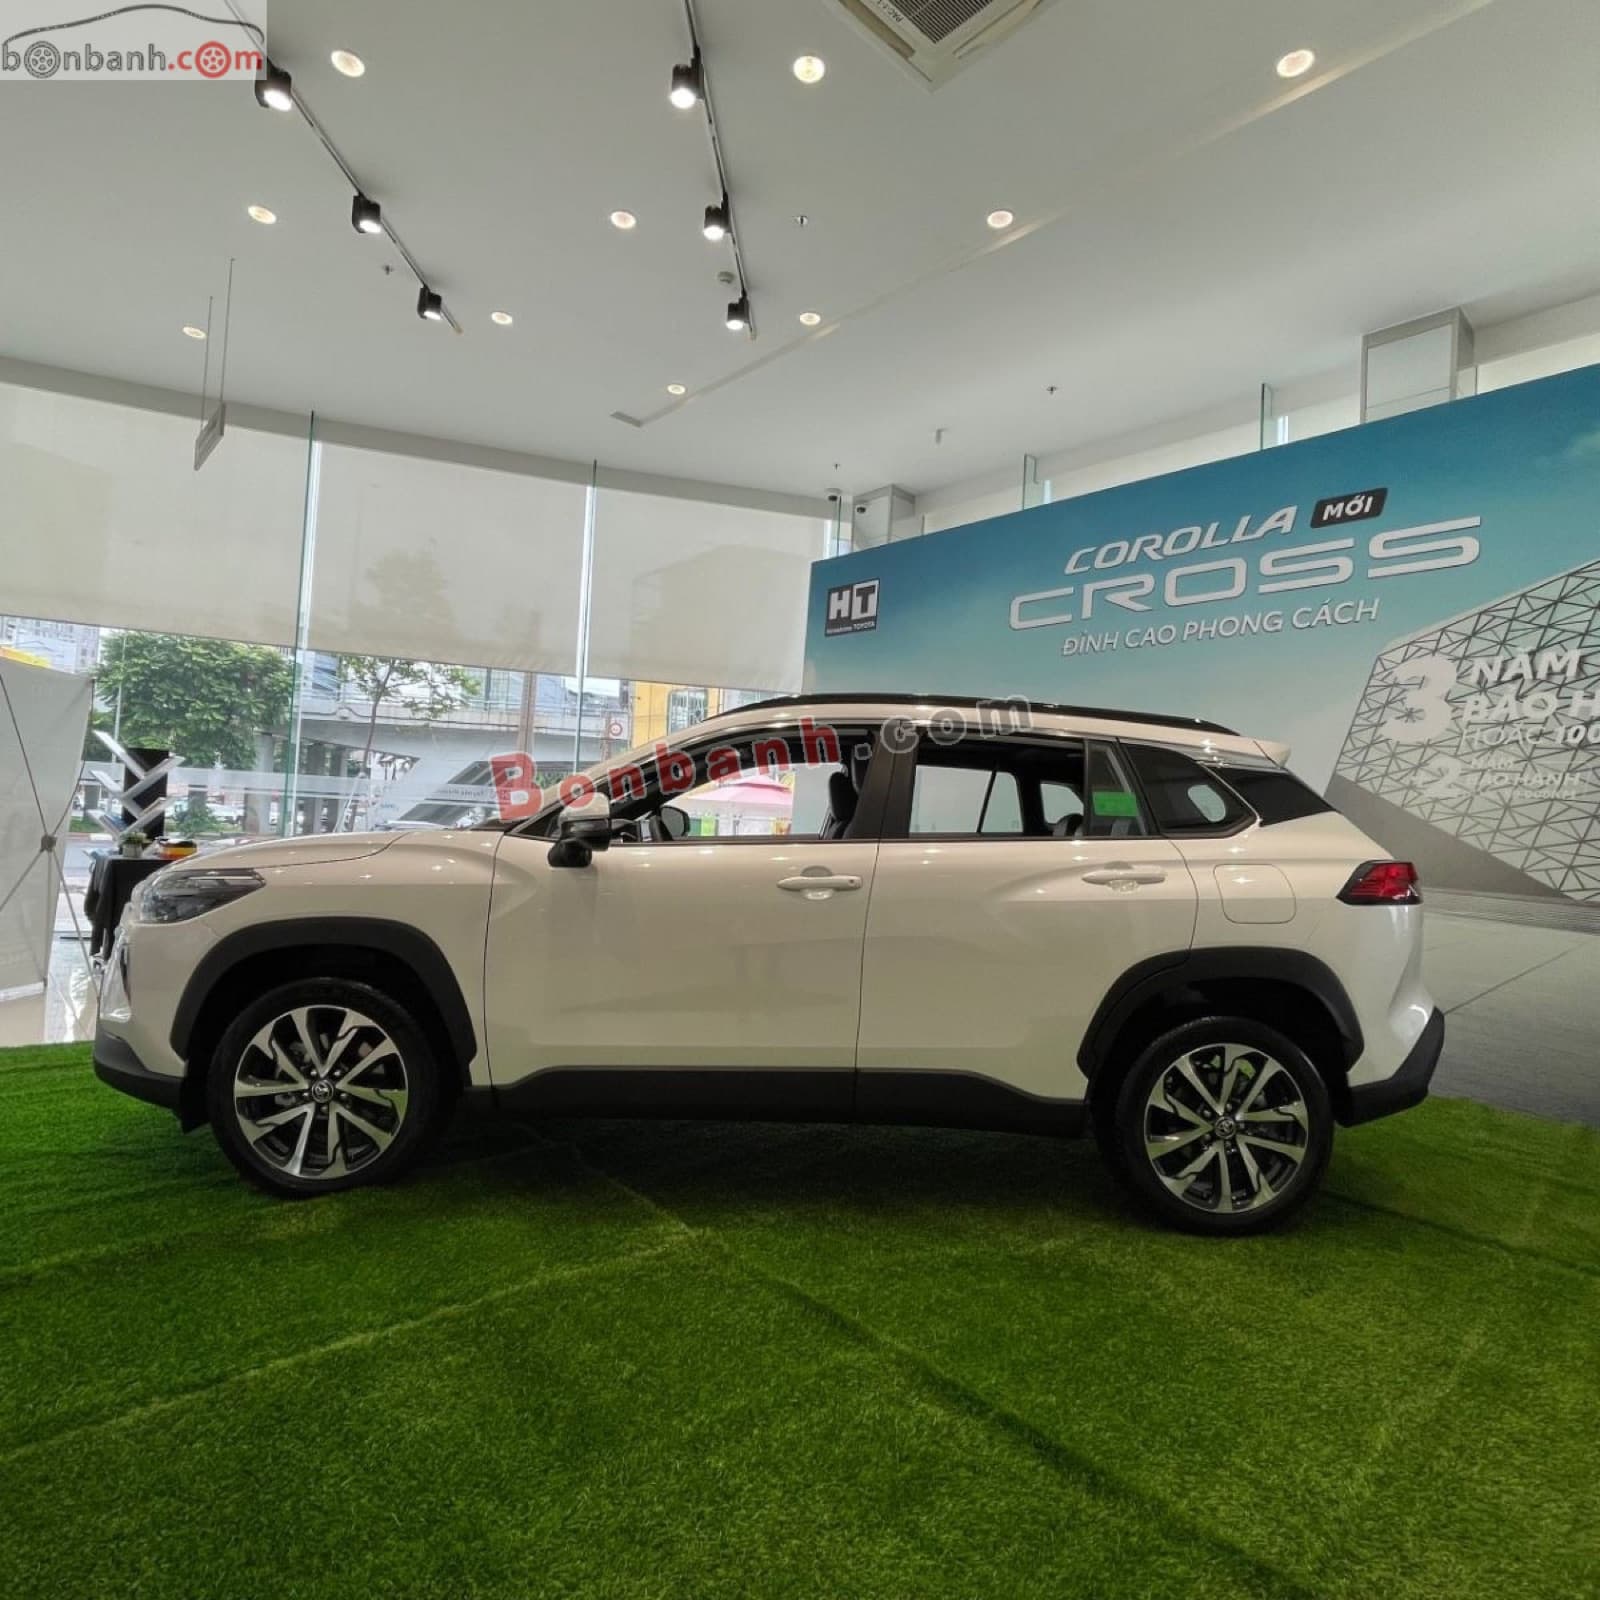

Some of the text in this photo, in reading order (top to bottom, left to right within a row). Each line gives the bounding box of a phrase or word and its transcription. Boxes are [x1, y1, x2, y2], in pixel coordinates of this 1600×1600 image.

[1064, 505, 1298, 575] COROLLA
[1322, 492, 1374, 522] MỚI
[1008, 516, 1481, 631] CROSS
[1124, 624, 1176, 647] CAO
[1182, 611, 1283, 642] PHONG
[1291, 598, 1381, 630] CÁCH
[1378, 655, 1458, 743] 3
